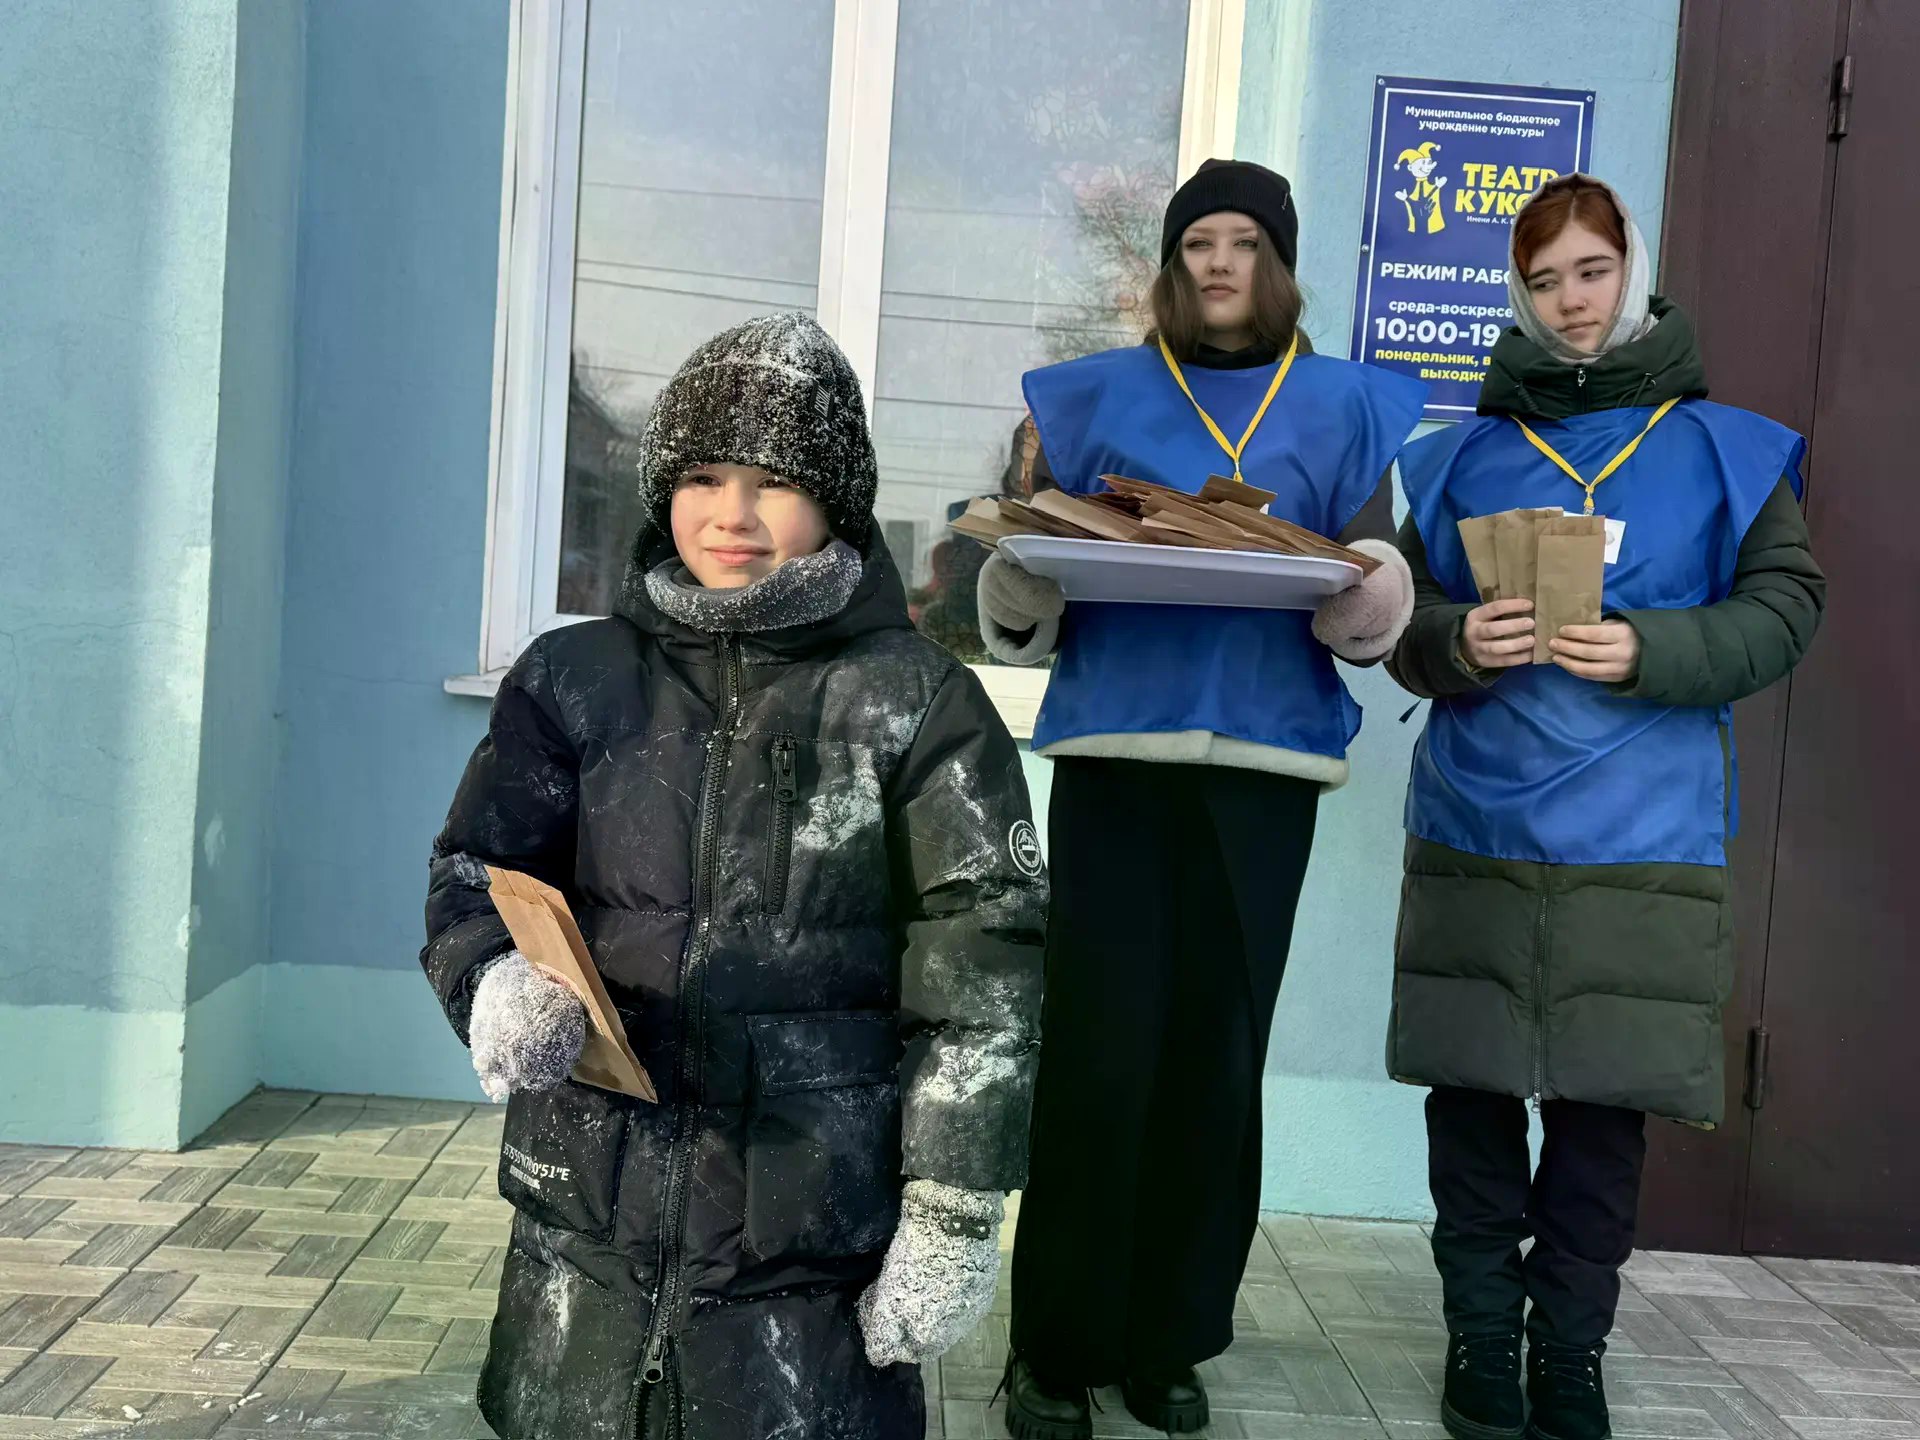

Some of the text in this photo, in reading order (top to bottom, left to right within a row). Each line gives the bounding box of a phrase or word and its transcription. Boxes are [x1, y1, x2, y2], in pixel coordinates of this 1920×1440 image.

[1405, 106, 1560, 126] Муниципальное бюджетное
[1419, 119, 1544, 137] учреждение культуры
[1466, 215, 1490, 224] Имени
[1491, 216, 1500, 224] А.
[1380, 262, 1457, 282] РЕЖИМ
[1388, 300, 1513, 318] среда-воскресе
[1375, 317, 1500, 347] 10:00-19
[1375, 349, 1479, 367] понедельник,
